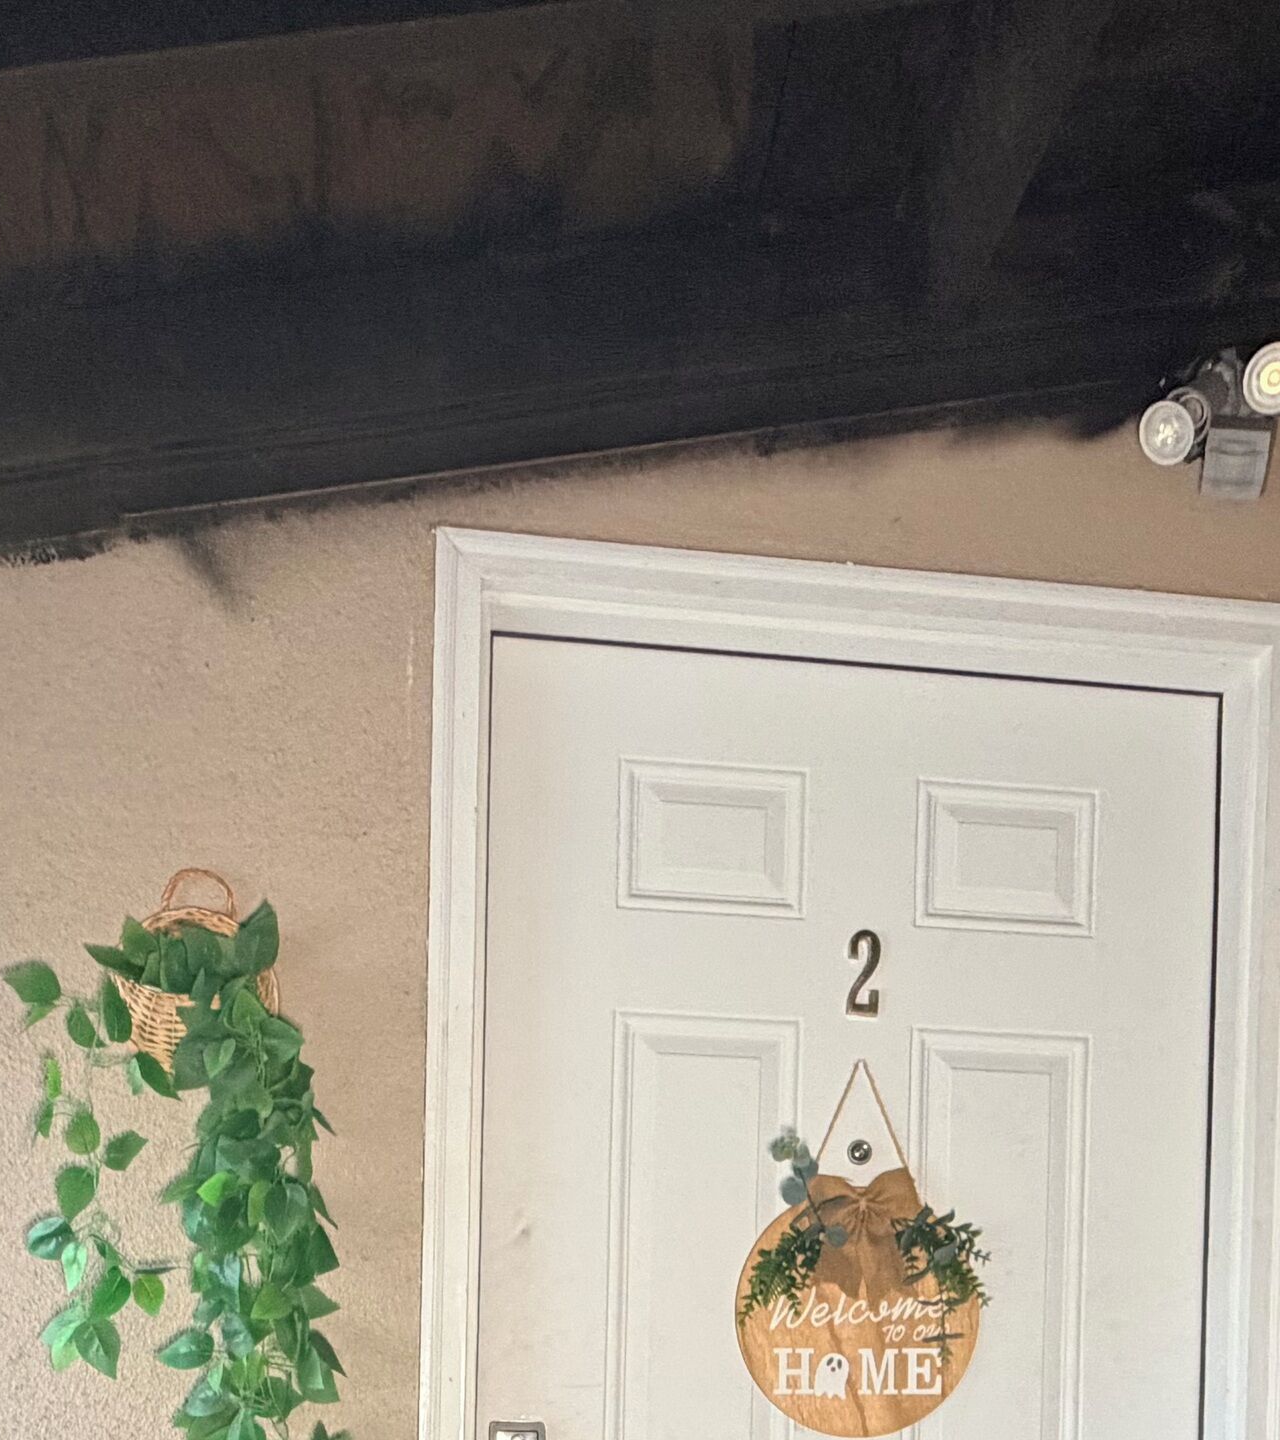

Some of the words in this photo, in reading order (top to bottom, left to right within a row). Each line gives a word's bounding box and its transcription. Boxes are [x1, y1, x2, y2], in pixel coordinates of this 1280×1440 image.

[846, 930, 881, 1017] 2
[768, 1286, 948, 1331] Welcome
[773, 1347, 942, 1398] HME
